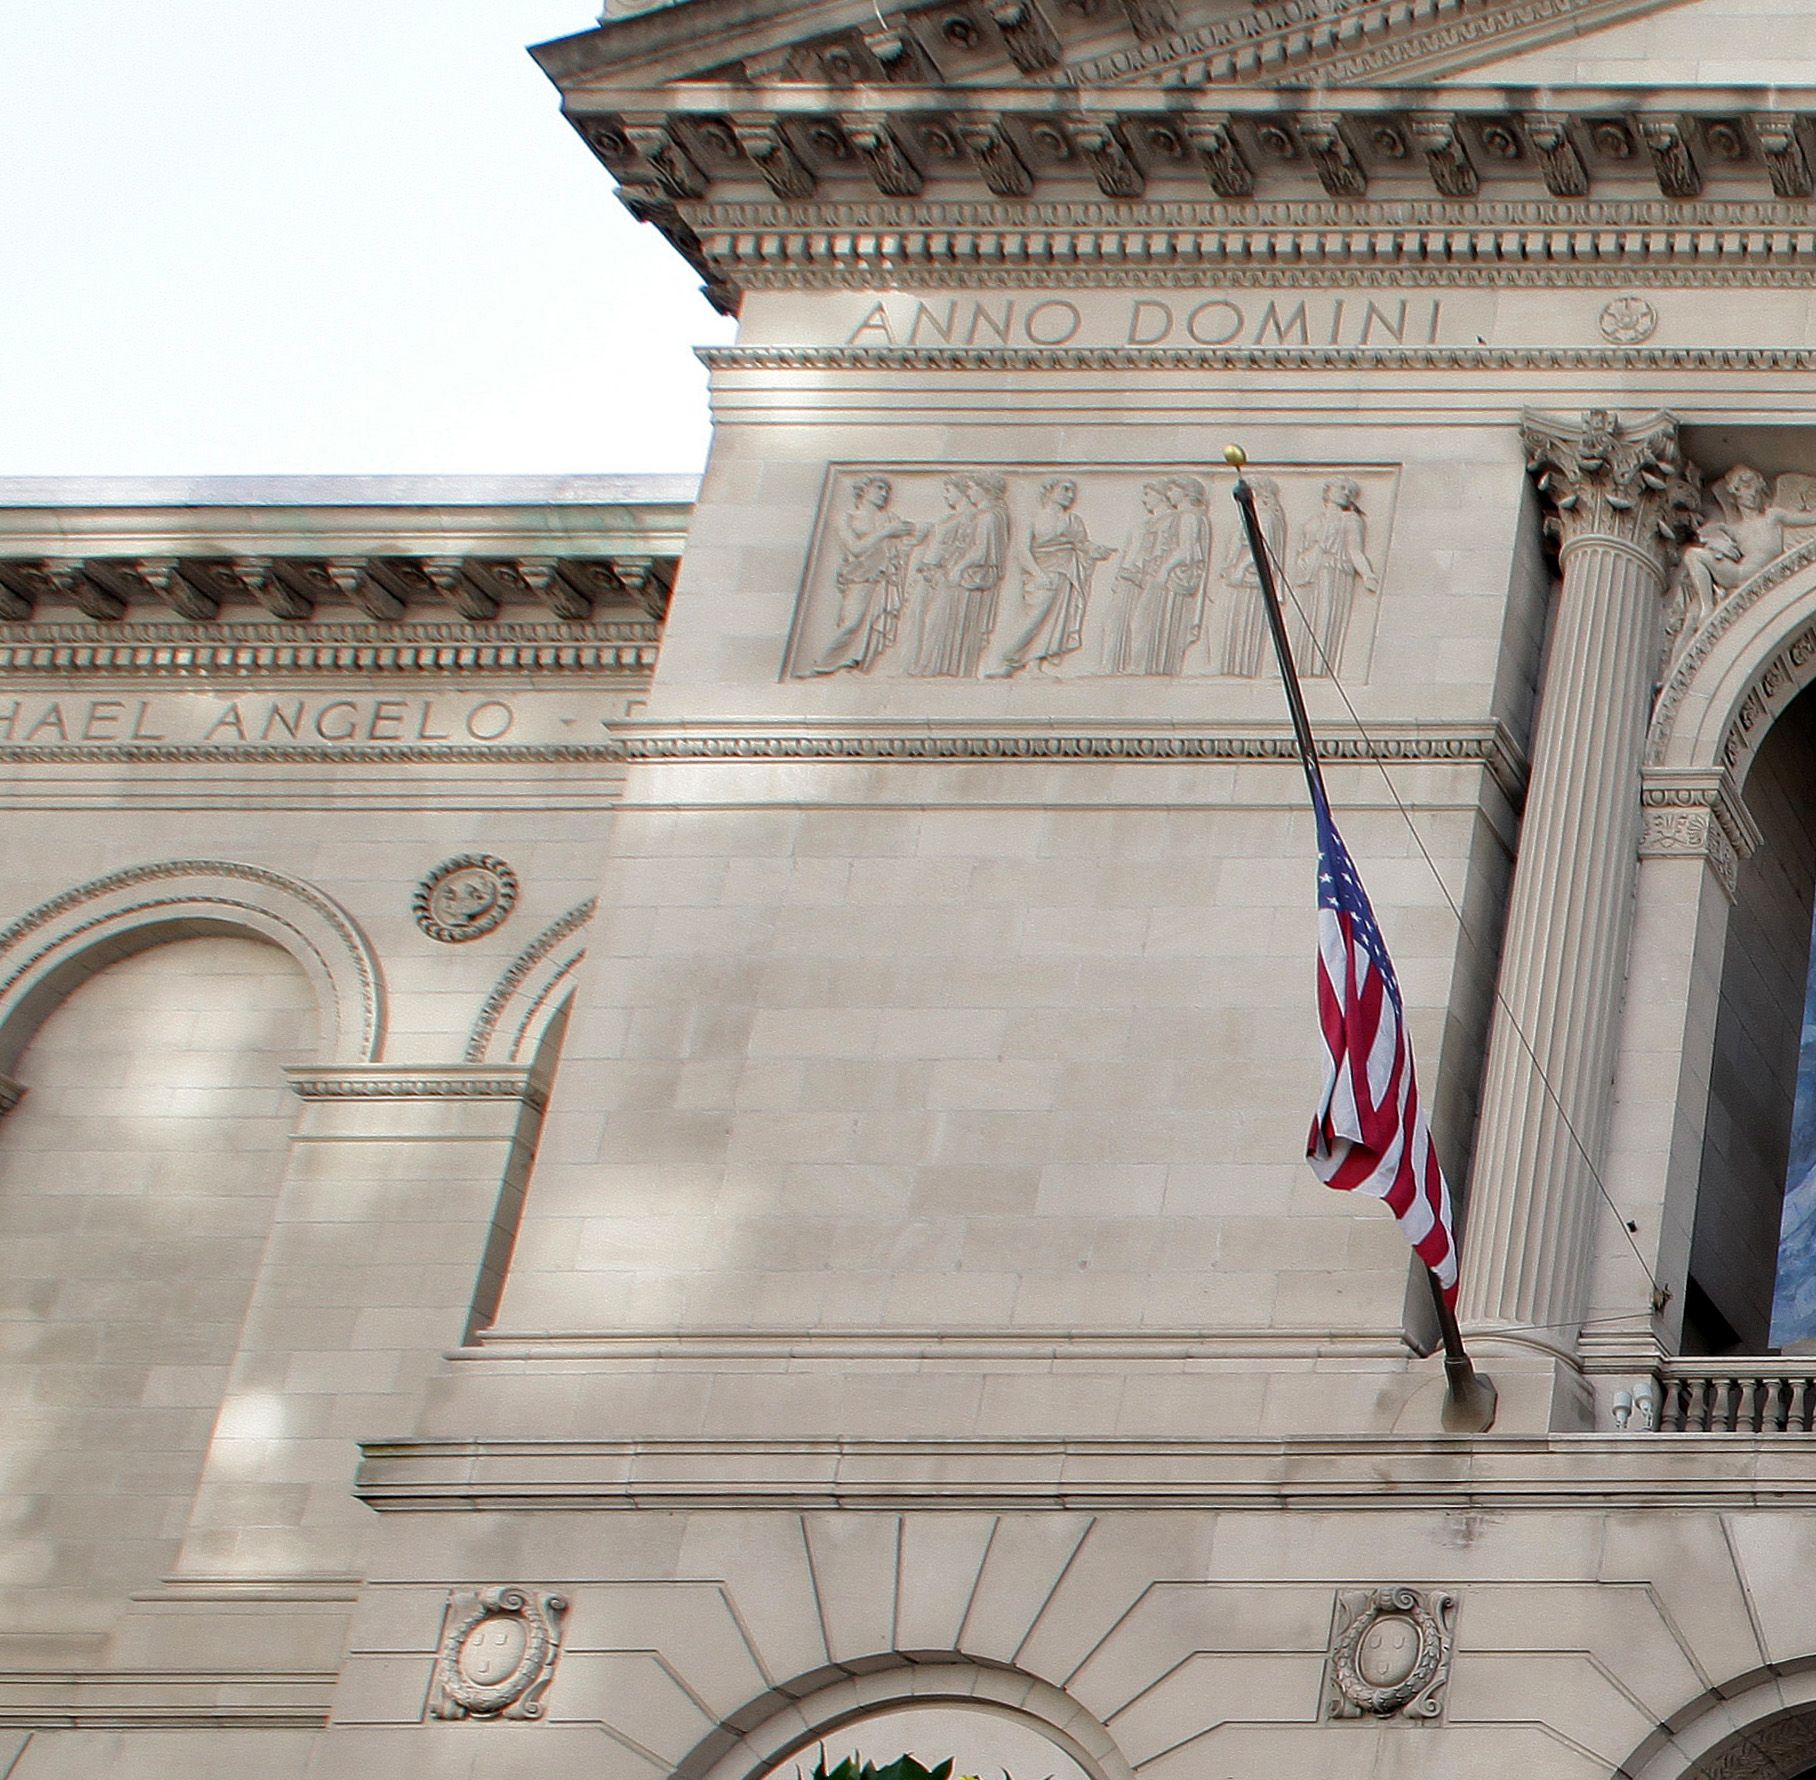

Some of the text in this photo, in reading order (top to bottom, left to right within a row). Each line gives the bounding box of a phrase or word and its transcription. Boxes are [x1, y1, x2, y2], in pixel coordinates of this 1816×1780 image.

[844, 299, 1443, 346] ANNO DOMINI
[203, 700, 515, 742] ANGELO
